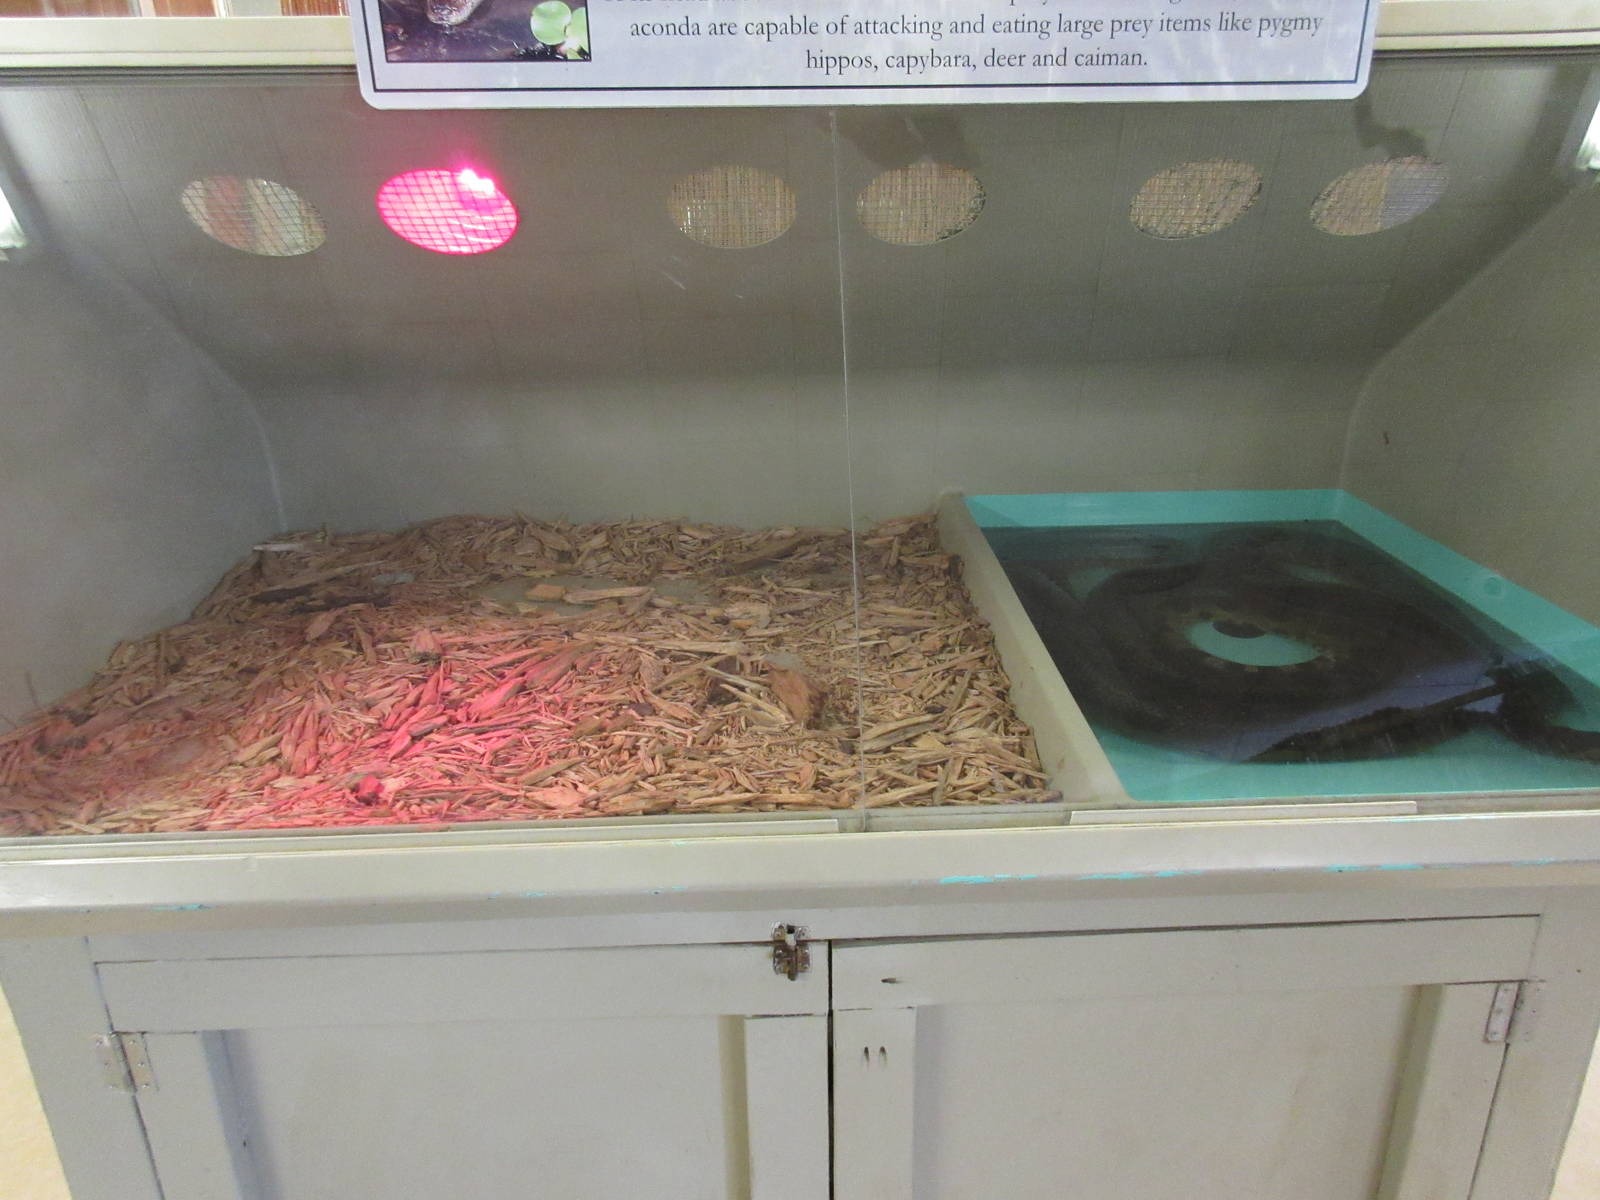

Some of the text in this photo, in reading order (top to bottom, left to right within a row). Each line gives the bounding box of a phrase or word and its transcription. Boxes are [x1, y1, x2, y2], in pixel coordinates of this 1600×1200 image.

[631, 11, 1323, 42] aconda are capable of attacking and eating large prey items like pygmy
[806, 45, 1147, 75] hippos, capybara, deer and caiman.
